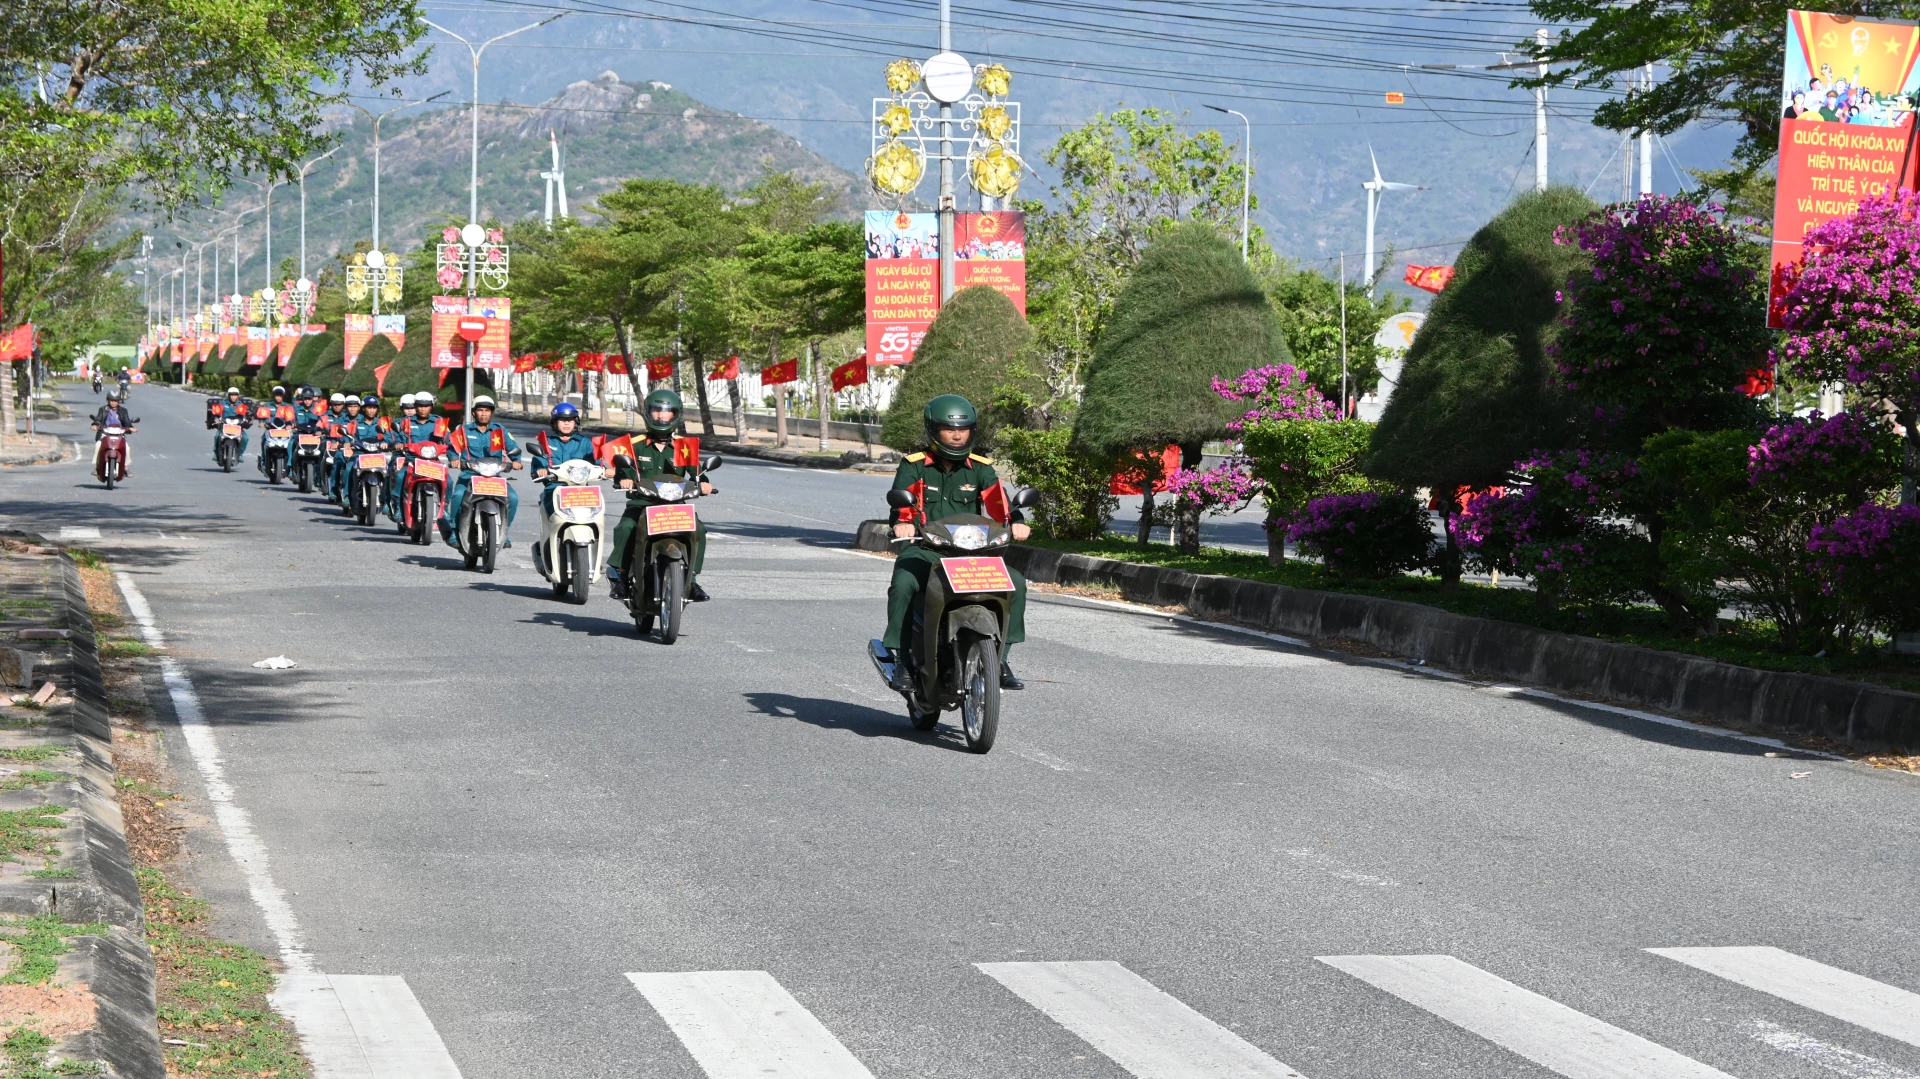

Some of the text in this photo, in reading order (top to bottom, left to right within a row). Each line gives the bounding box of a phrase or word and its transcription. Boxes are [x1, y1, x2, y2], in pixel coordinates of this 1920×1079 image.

[1794, 125, 1905, 152] QUỐC HỘI KHÓA XVI
[1807, 151, 1895, 174] HIỆN THÂN CỦA
[1811, 174, 1831, 191] TRÍ
[1832, 176, 1857, 195] TUỆ,
[1860, 177, 1869, 194] Ý
[1797, 195, 1813, 212] VÀ
[875, 262, 932, 276] NGÀY BẦU CỬ
[972, 264, 1002, 273] QUỐC HỘI
[877, 278, 931, 291] LÀ NGÀY HỘI
[874, 290, 934, 306] ĐẠI ĐOÀN KẾT
[872, 307, 896, 318] TOÀN
[897, 307, 916, 318] DÂN
[880, 332, 909, 352] 5G
